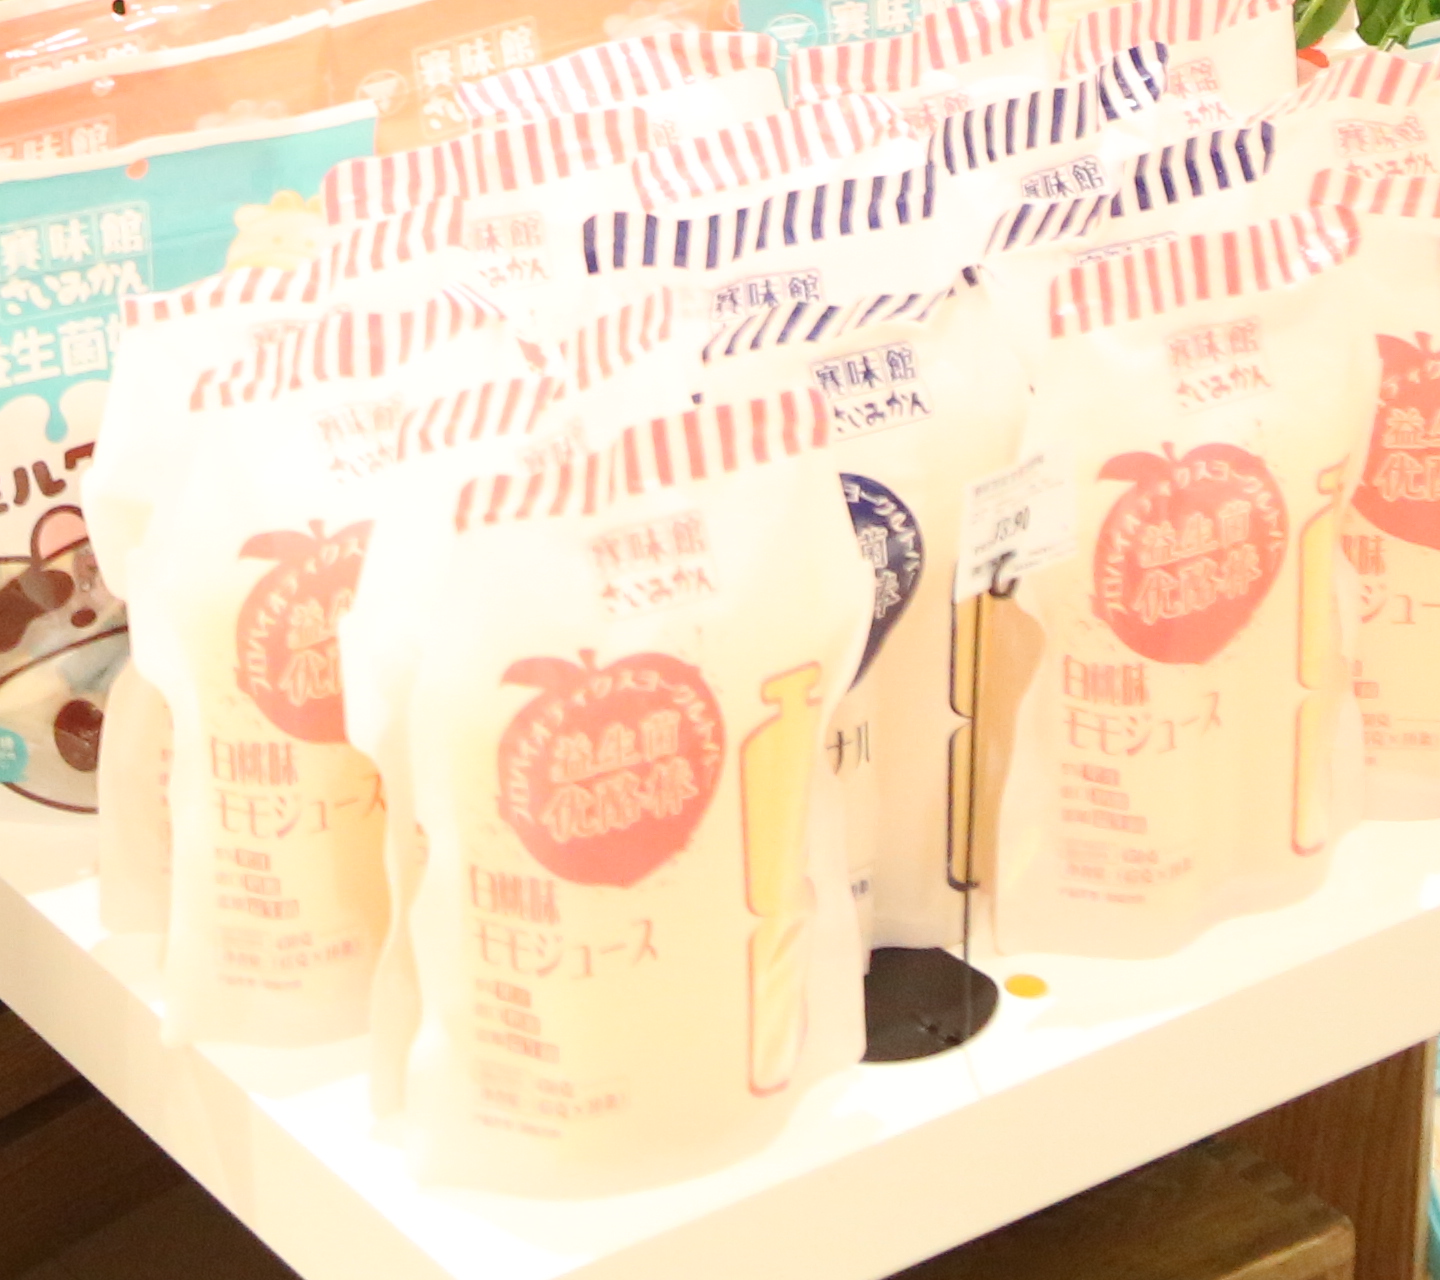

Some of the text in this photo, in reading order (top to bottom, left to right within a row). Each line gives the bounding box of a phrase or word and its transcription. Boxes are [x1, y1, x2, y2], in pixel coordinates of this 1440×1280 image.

[1141, 503, 1251, 572] 益生菌
[1133, 552, 1262, 619] 优酪棒
[1064, 691, 1224, 755] モモジュース
